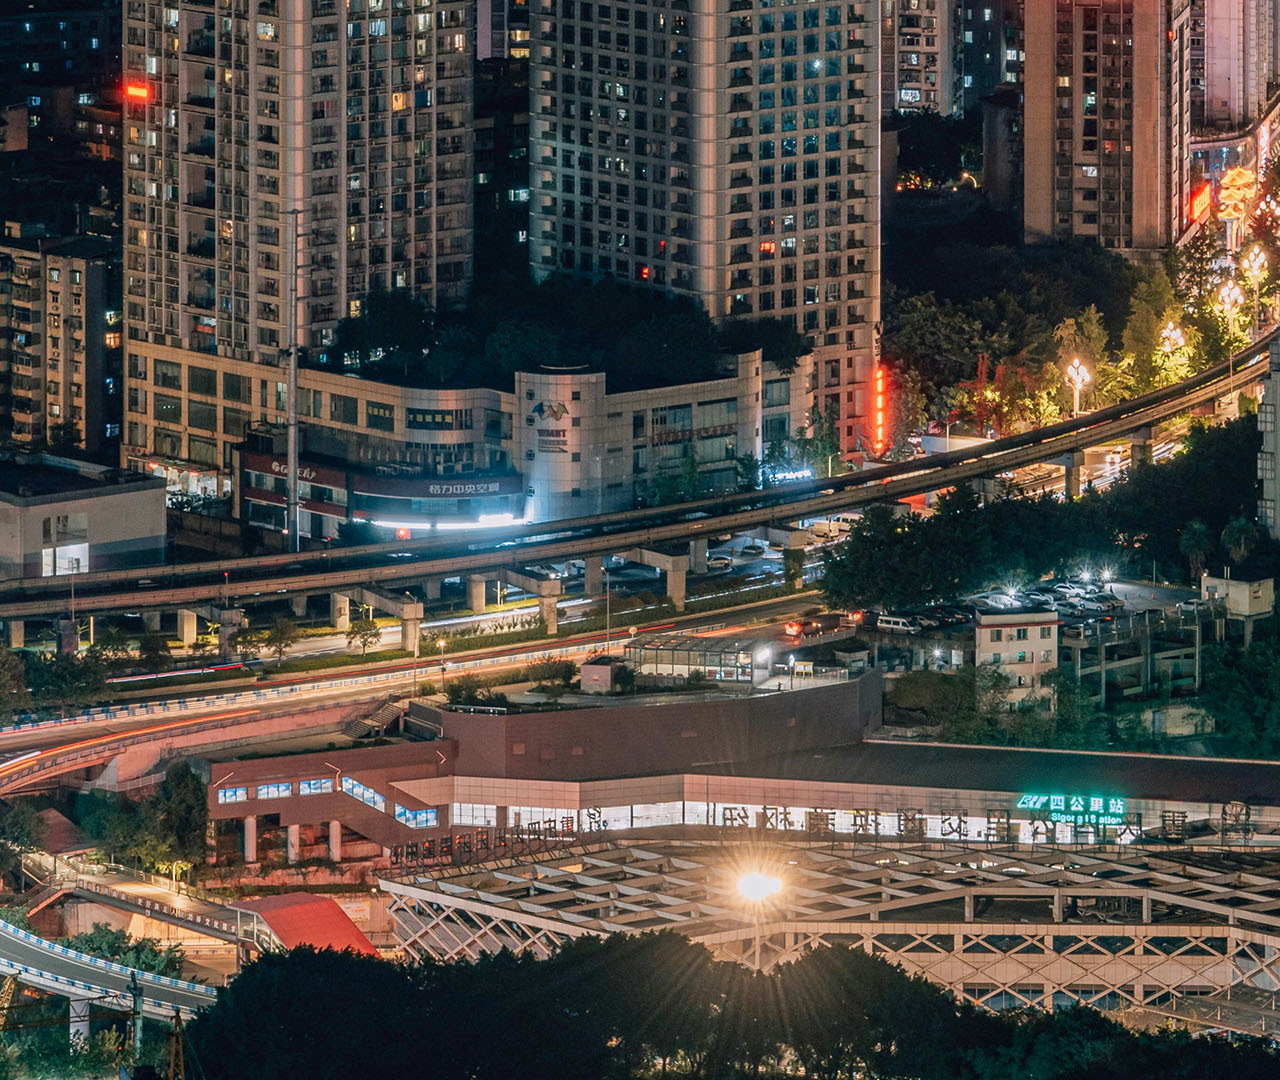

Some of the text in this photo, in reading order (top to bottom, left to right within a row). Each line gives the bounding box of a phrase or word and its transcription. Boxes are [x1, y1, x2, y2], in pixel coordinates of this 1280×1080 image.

[1050, 794, 1125, 814] 四公里站
[1090, 814, 1123, 825] Sation
